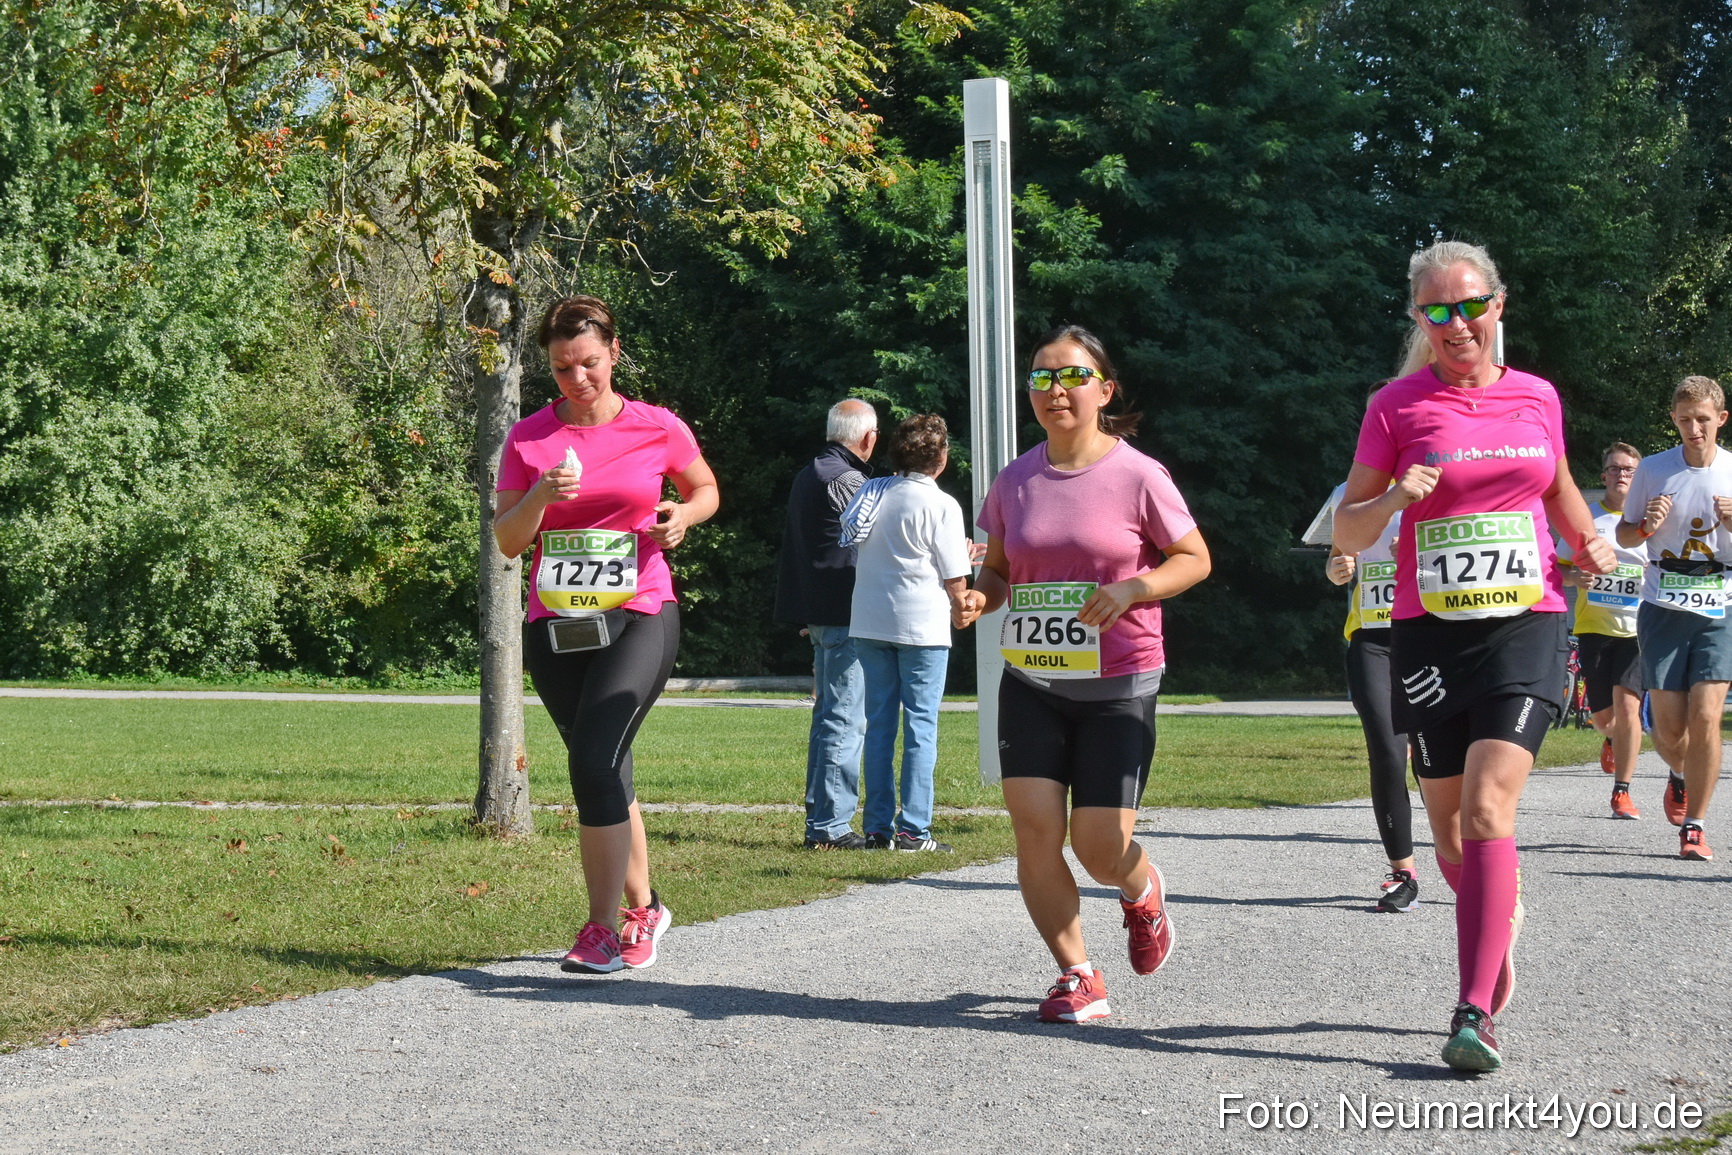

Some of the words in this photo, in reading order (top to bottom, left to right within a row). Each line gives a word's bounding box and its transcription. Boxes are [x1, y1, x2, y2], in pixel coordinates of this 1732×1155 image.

[1425, 444, 1546, 466] Mädchenband
[1426, 518, 1524, 546] BOCK
[550, 534, 625, 552] BOCK
[551, 561, 624, 586] 1273
[1367, 564, 1396, 579] BO
[1432, 549, 1527, 584] 1274
[1614, 565, 1637, 576] CK
[1593, 577, 1635, 594] 2218
[1665, 575, 1717, 587] BOCK
[570, 595, 599, 606] EVA
[1017, 588, 1085, 608] BOCK
[1370, 583, 1395, 604] 10
[1444, 590, 1518, 608] MARION
[1601, 595, 1623, 604] LUCA
[1666, 593, 1716, 607] 2294
[1377, 611, 1391, 619] NA
[1011, 616, 1086, 645] 1266
[1024, 654, 1068, 667] AIGUL
